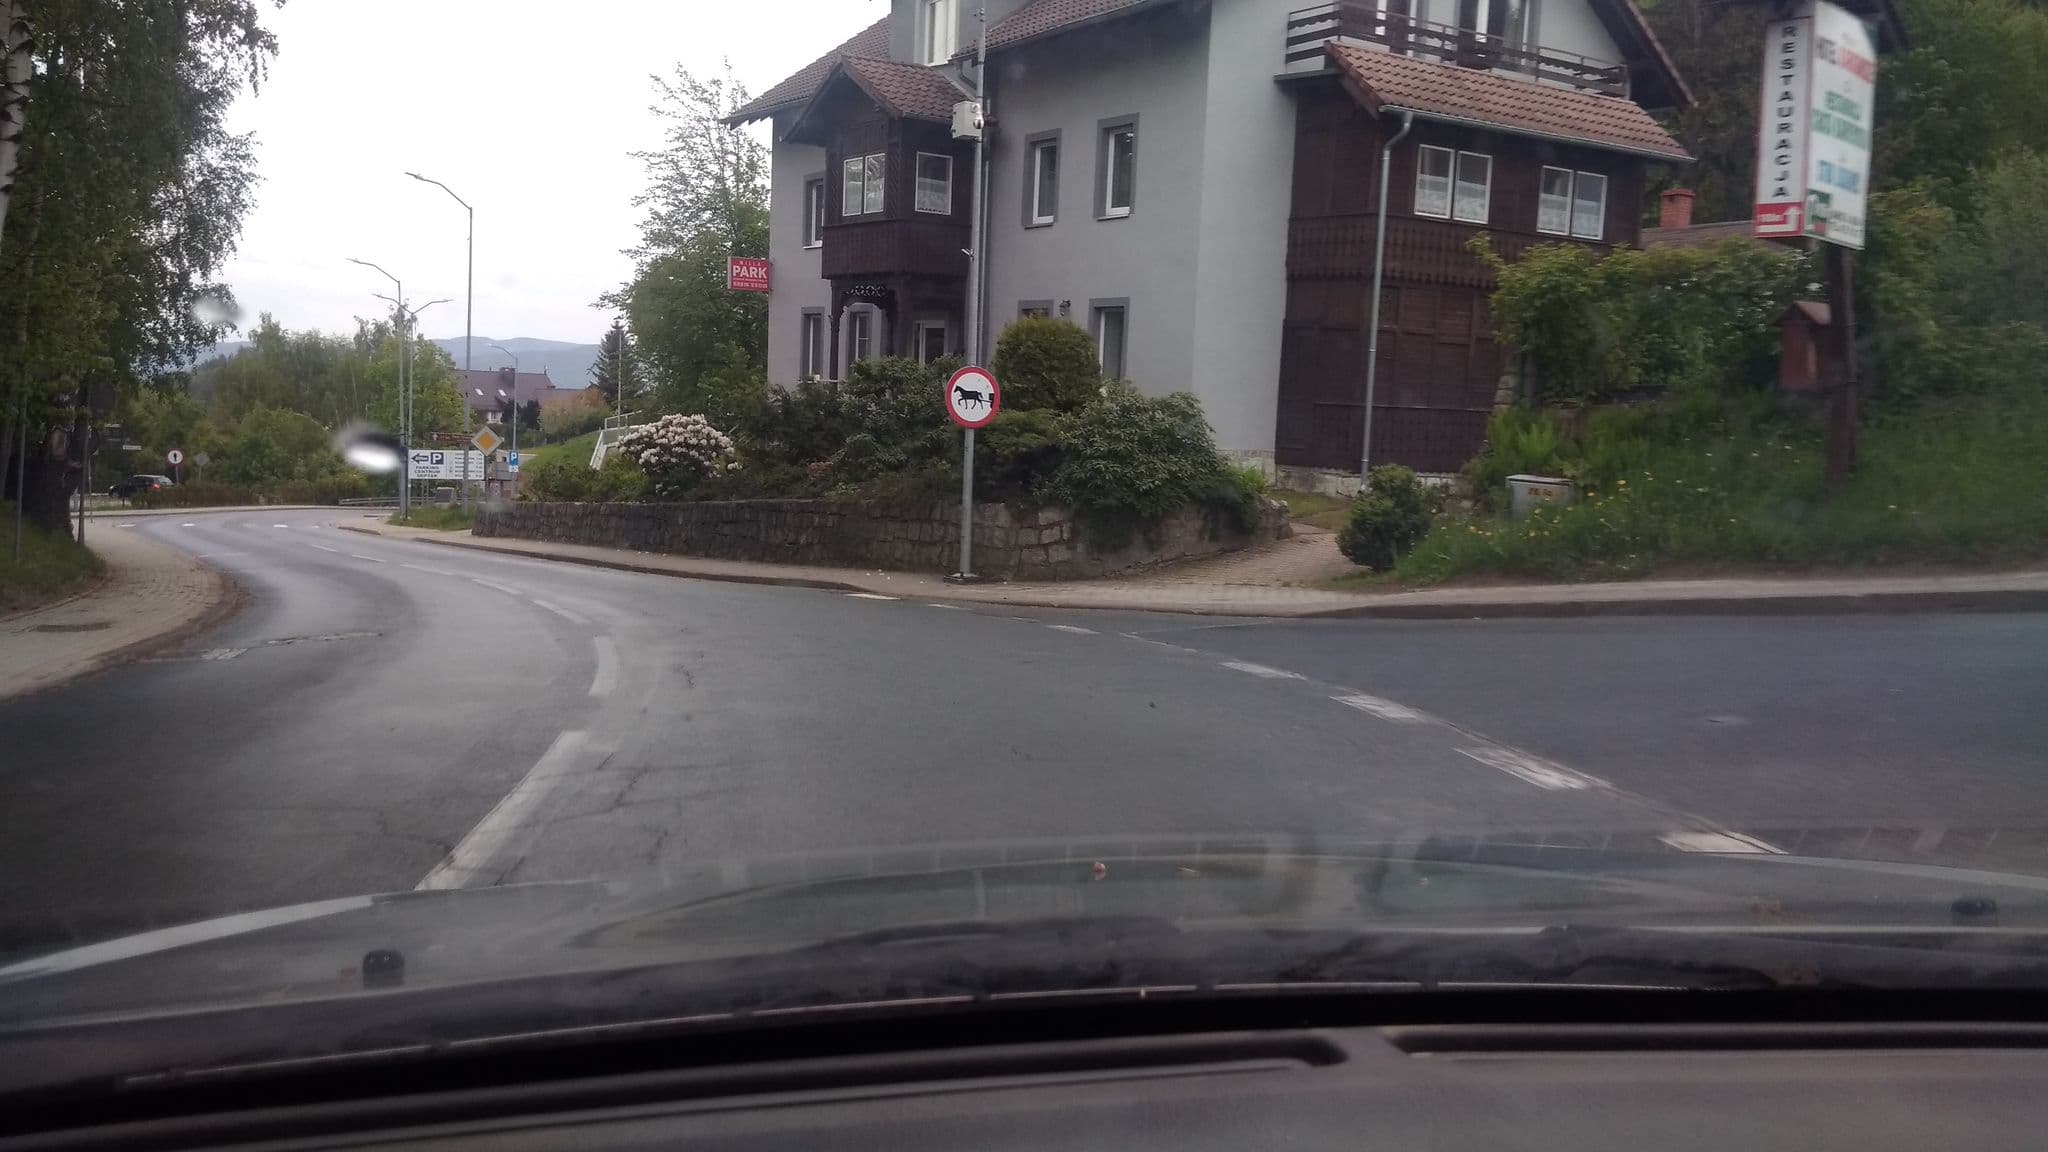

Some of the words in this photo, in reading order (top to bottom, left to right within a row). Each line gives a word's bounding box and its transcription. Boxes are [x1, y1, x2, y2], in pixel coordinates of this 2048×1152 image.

[1772, 25, 1797, 198] RESTAURACJA
[732, 265, 767, 279] PARK
[432, 453, 442, 464] P
[510, 451, 517, 461] P
